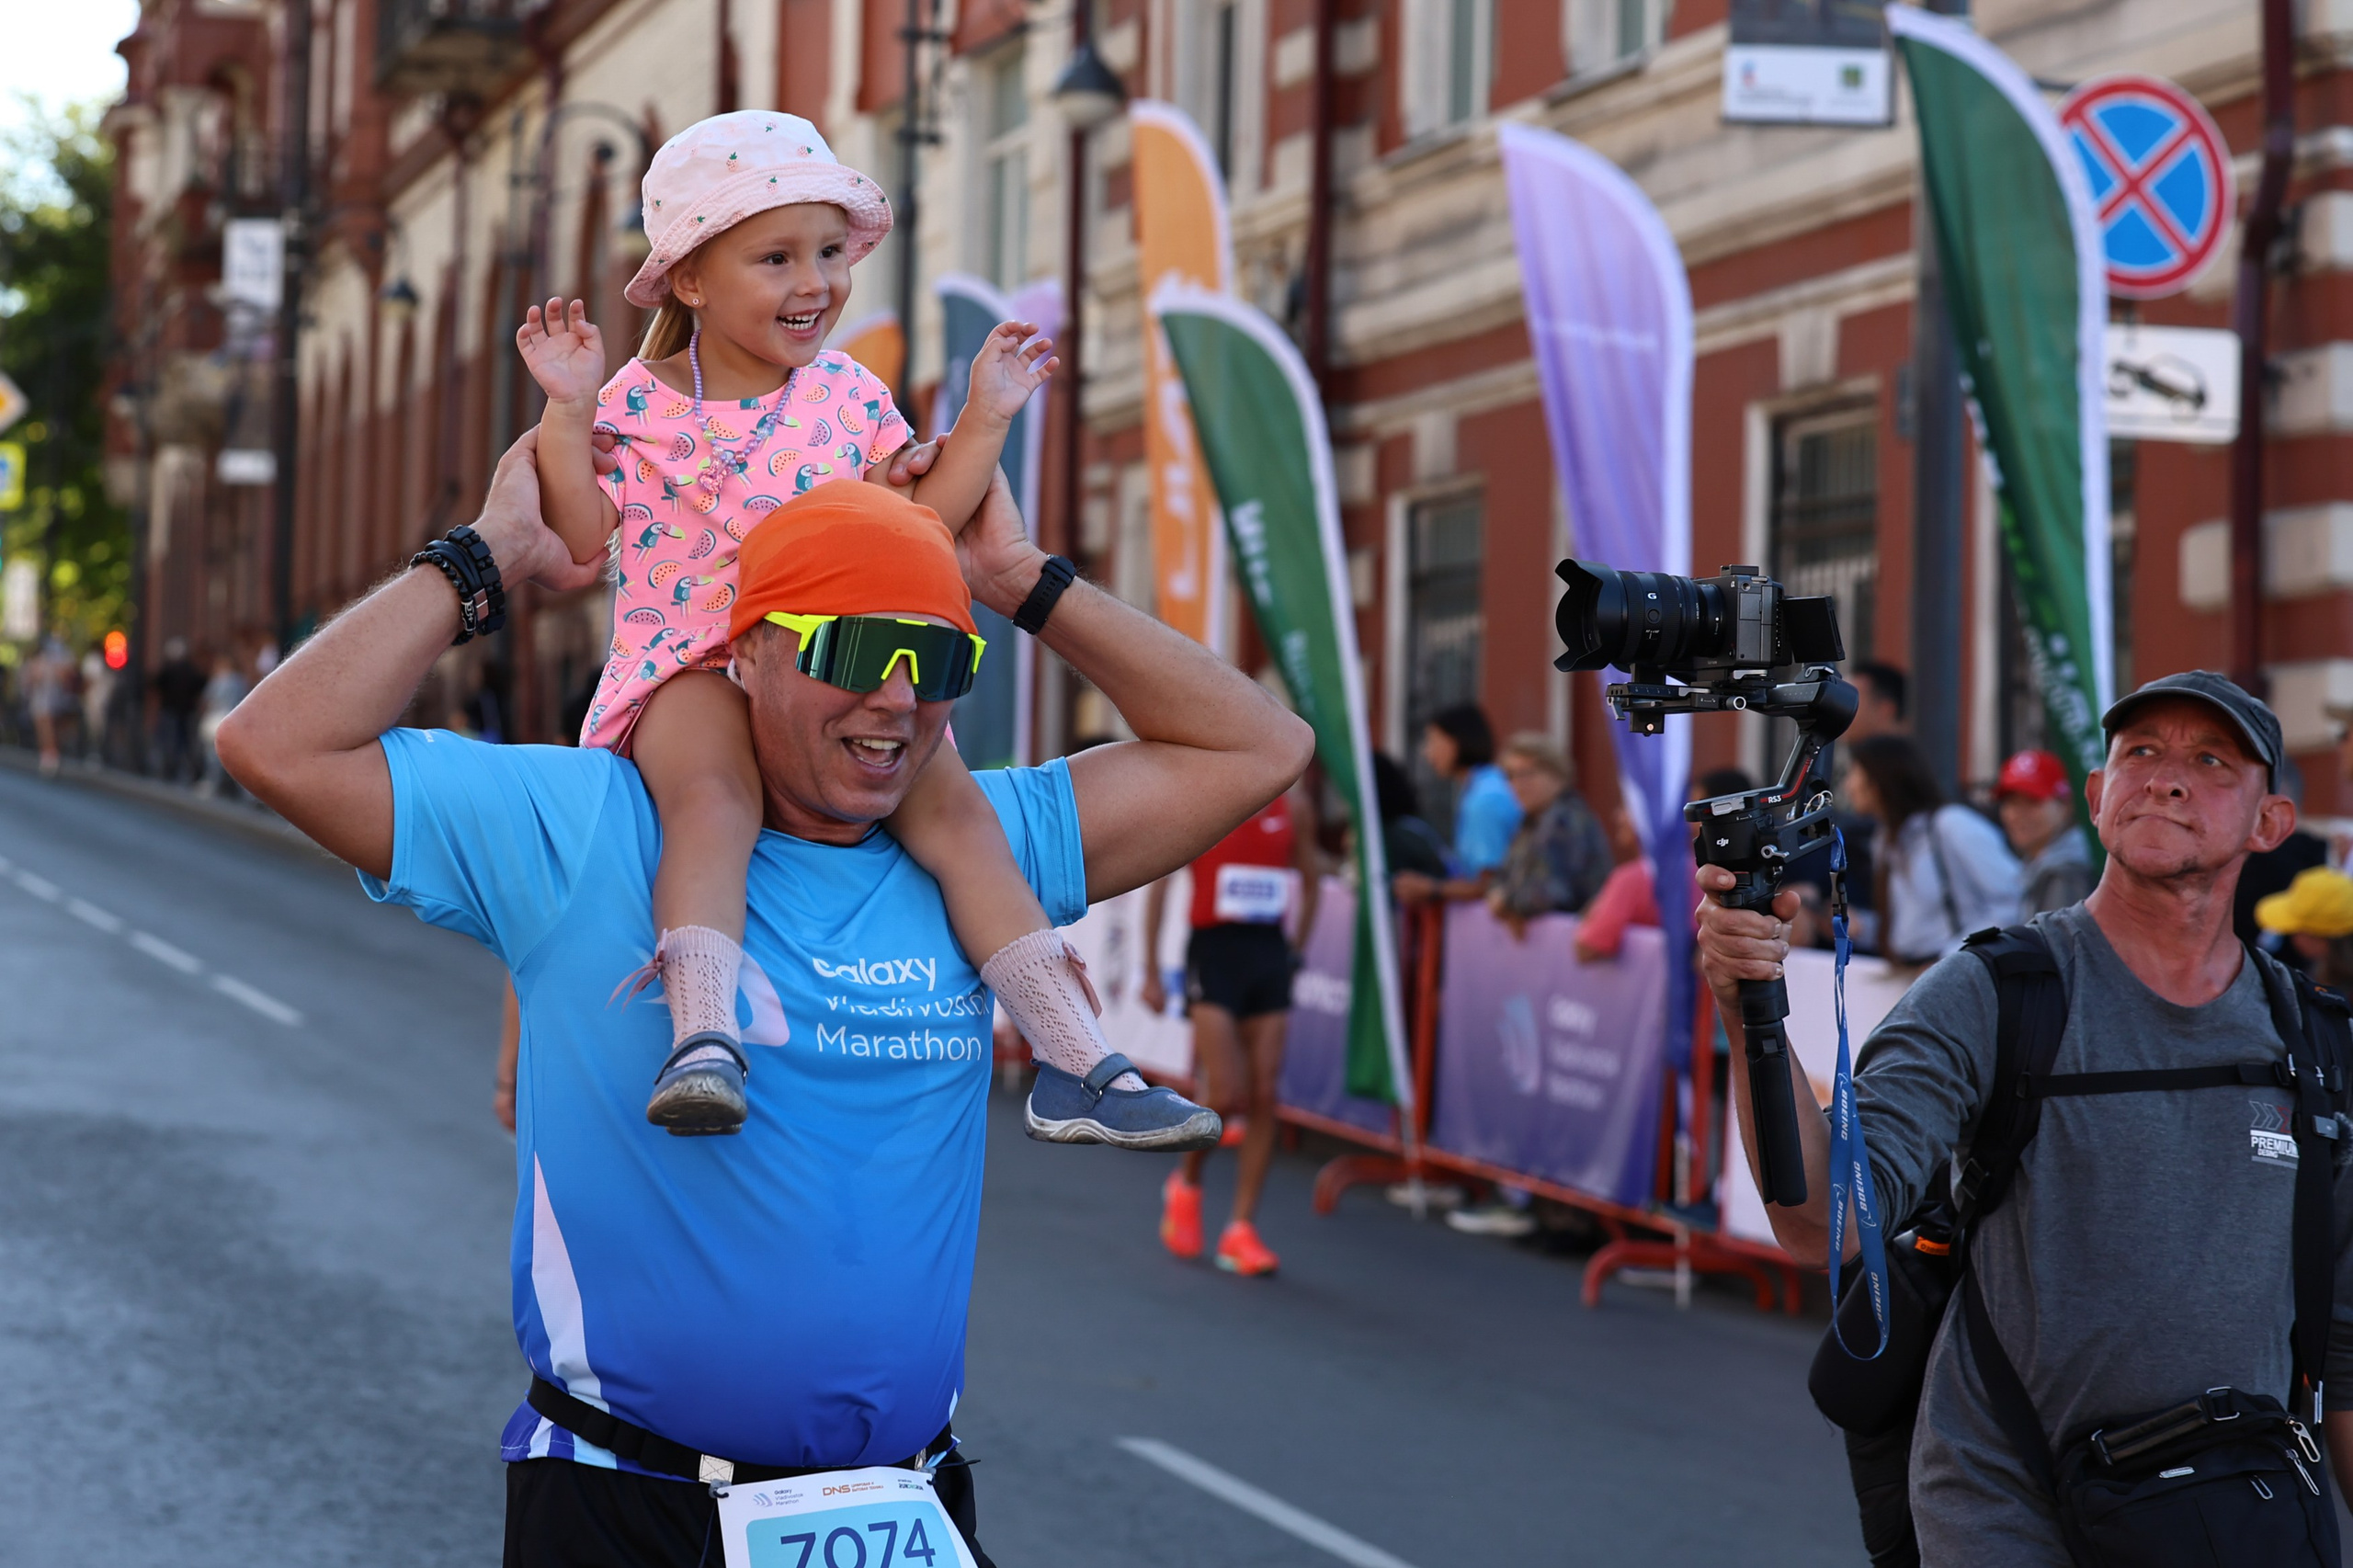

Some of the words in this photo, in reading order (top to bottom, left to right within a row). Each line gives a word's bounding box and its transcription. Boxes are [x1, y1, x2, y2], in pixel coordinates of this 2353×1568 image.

[1768, 795, 1782, 804] RS3
[816, 1022, 983, 1062] Marathon
[1841, 1088, 1849, 1142] BOEING
[1853, 1161, 1869, 1212] BOEING
[1835, 1199, 1844, 1252] BOEING
[823, 1484, 851, 1496] DNS
[779, 1517, 937, 1568] 7074
